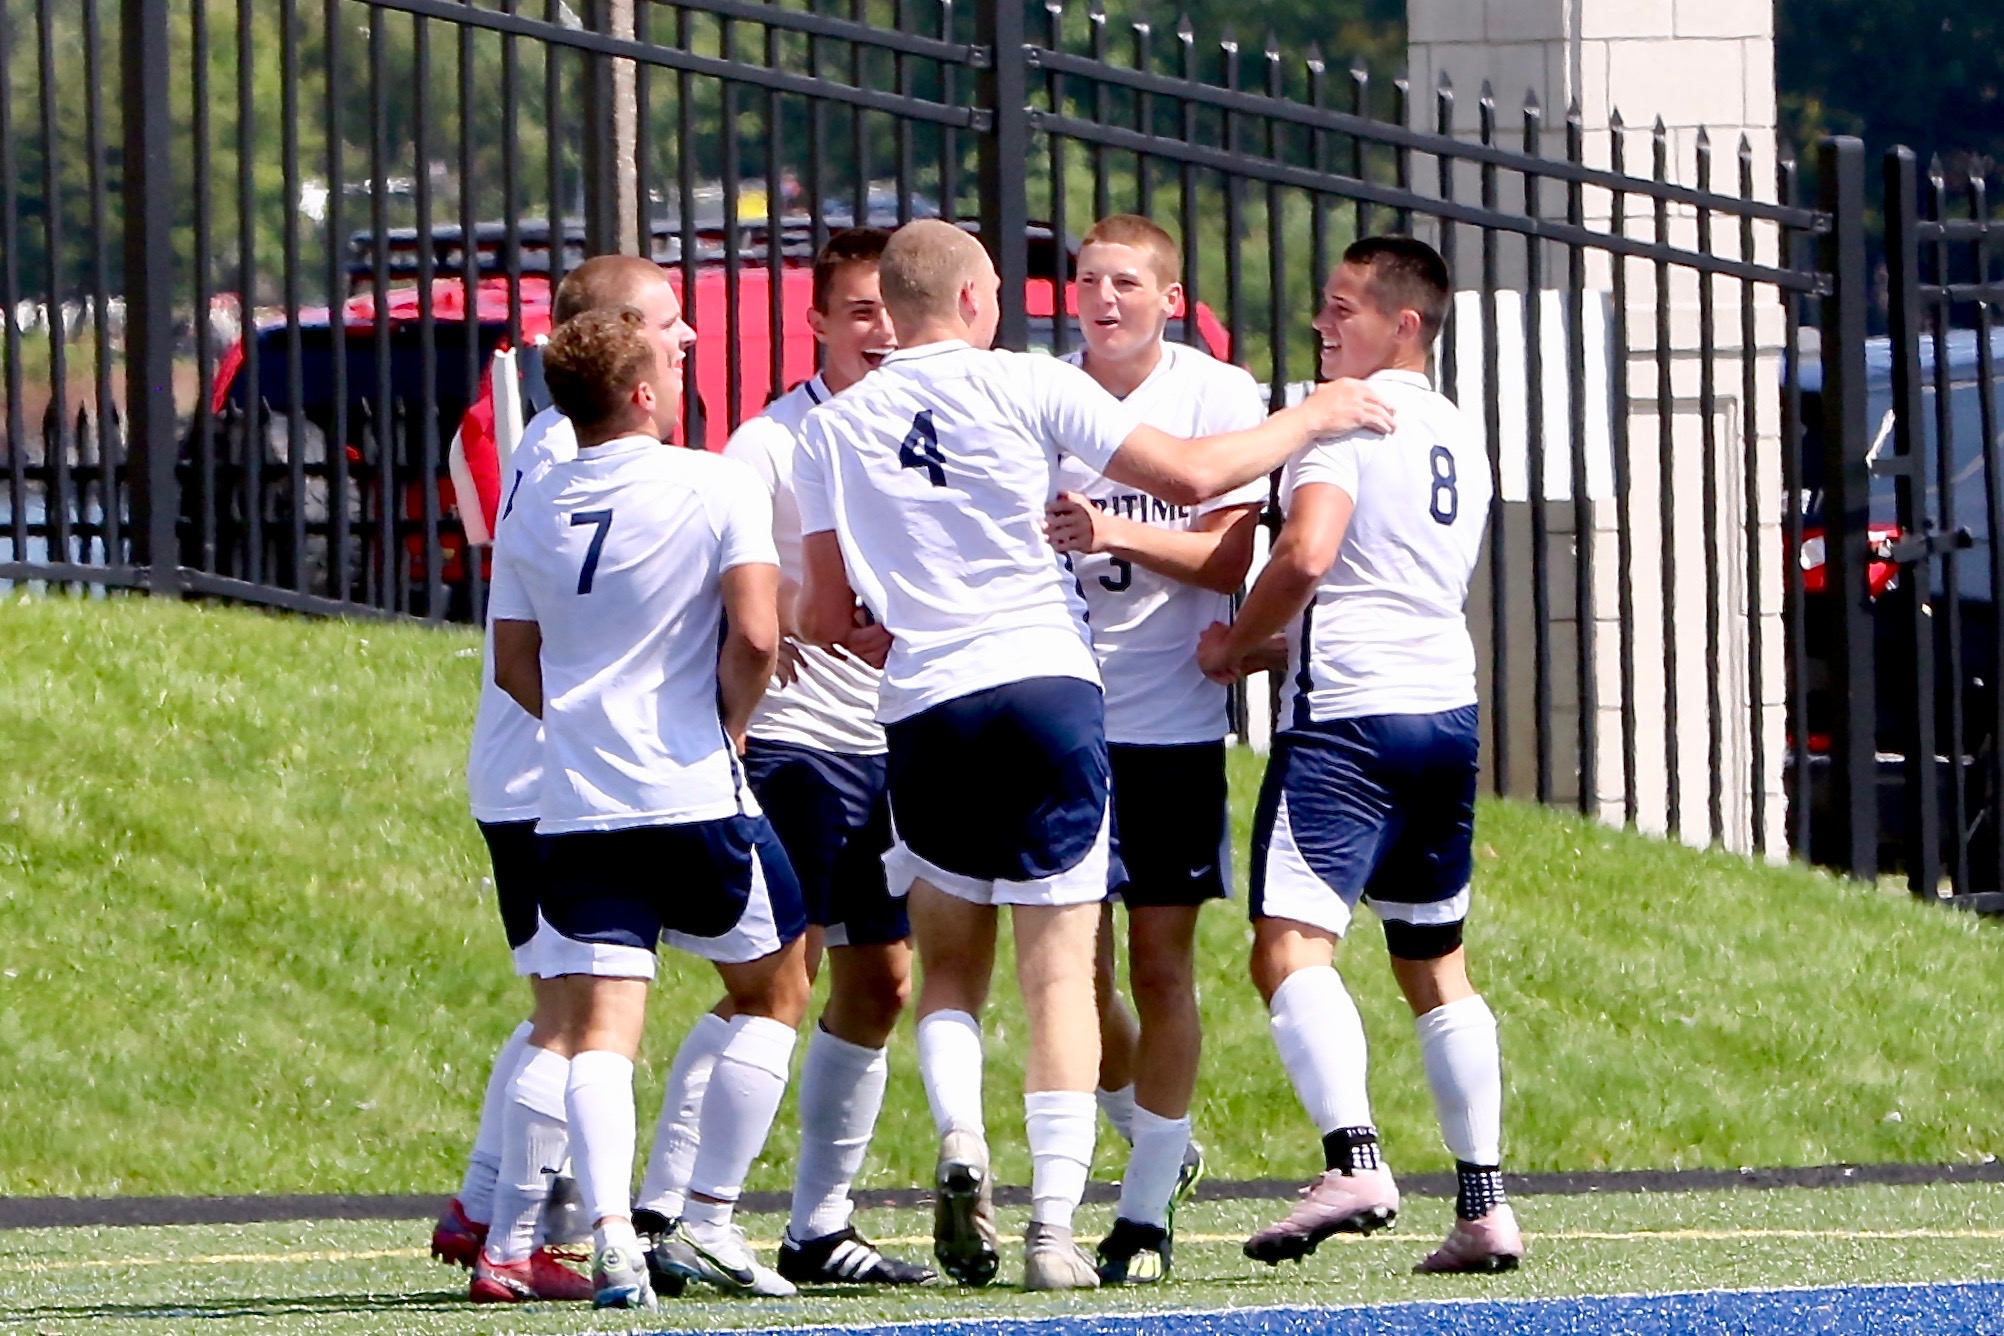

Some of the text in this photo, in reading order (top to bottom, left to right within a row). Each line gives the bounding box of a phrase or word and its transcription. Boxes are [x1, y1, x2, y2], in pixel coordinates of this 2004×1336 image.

[899, 409, 947, 487] 4
[1429, 444, 1458, 526] 8
[570, 508, 613, 594] 7
